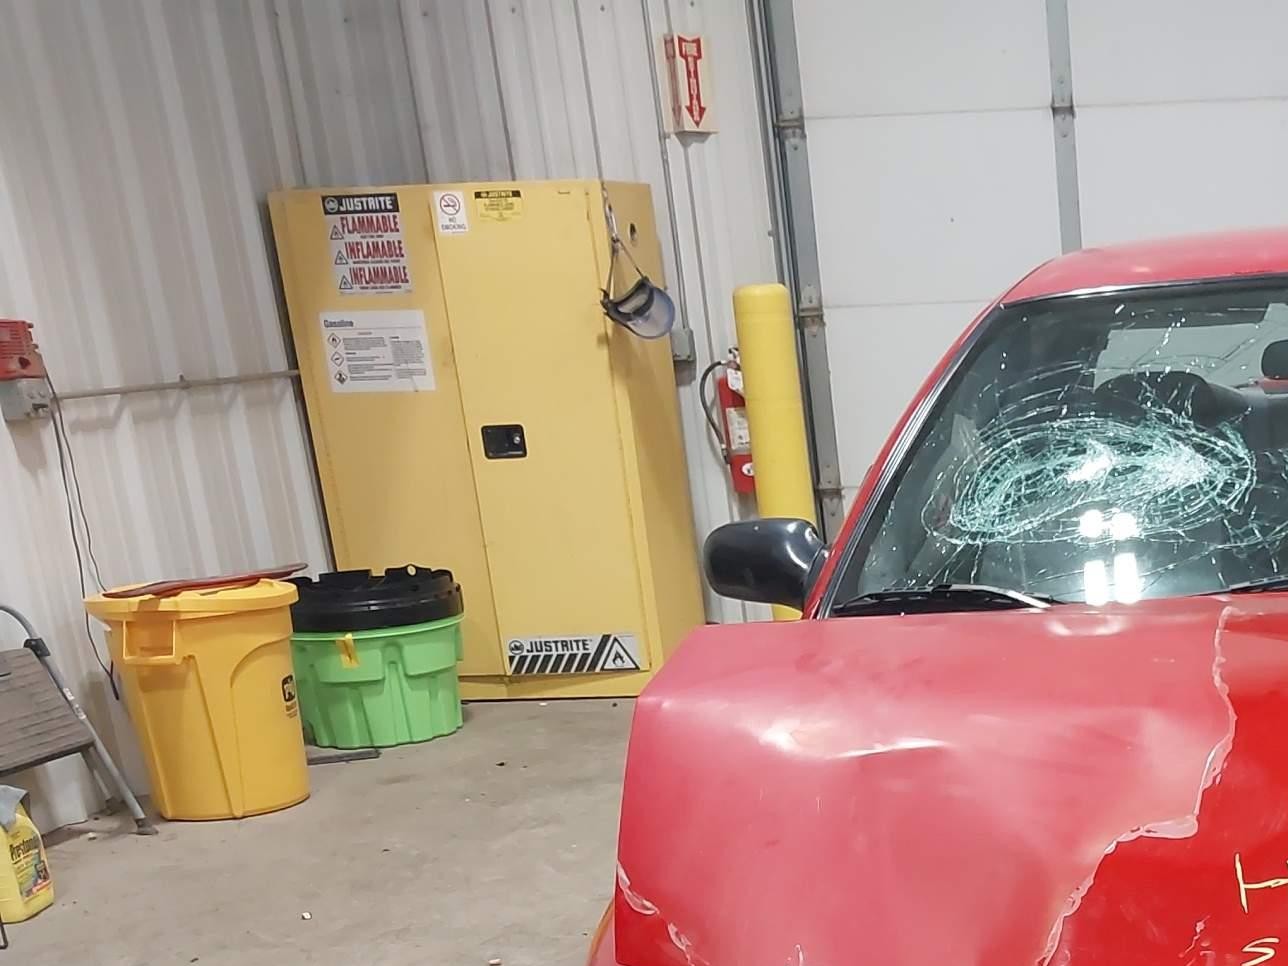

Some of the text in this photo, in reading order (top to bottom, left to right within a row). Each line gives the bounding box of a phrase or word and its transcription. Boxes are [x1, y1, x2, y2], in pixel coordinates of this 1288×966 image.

[340, 196, 394, 211] JUSTRITE
[340, 214, 399, 234] FLAMMABLE
[345, 240, 404, 259] INFLAMABLE
[349, 266, 409, 285] INFLAMMABLE
[526, 639, 590, 653] JUSTRITE
